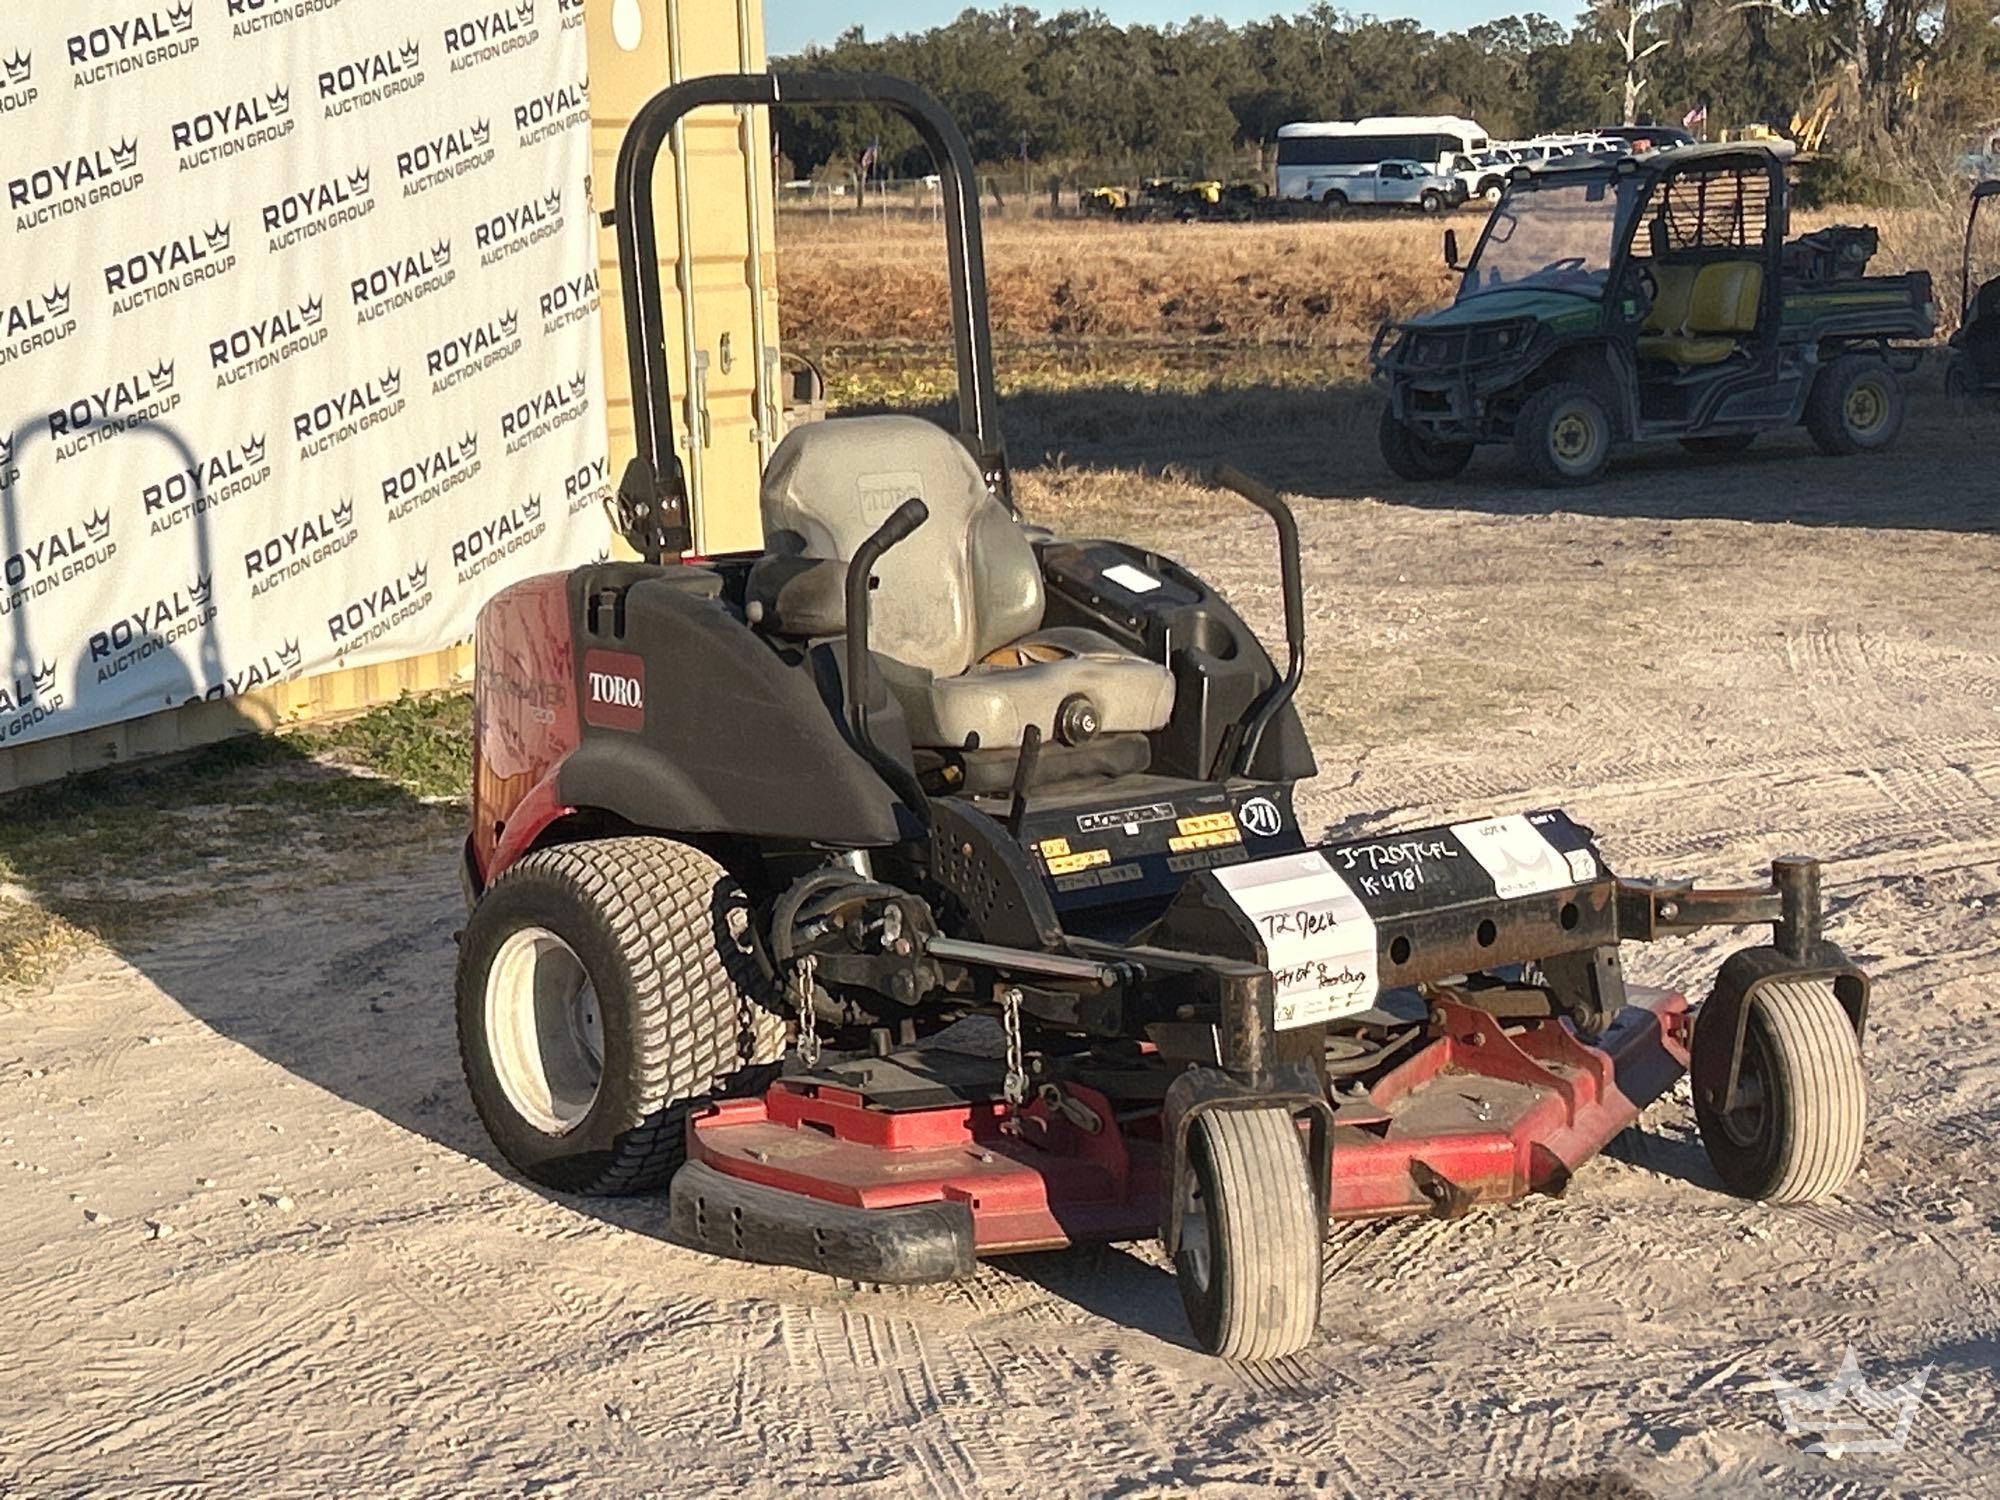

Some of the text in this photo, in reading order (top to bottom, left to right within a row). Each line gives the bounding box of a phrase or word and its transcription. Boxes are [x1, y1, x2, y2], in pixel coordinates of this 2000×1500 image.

[67, 13, 169, 66] ROYAL
[233, 7, 293, 40] AUCTION
[445, 10, 518, 53] ROYAL
[451, 30, 539, 72] AUCTION GROUP
[74, 37, 199, 89] AUCTION GROUP
[319, 51, 400, 99] ROYAL
[325, 72, 424, 119] AUCTION GROUP
[514, 85, 581, 130] ROYAL
[172, 98, 268, 151] ROYAL
[179, 119, 294, 172] AUCTION GROUP
[520, 120, 565, 148] AUCTION
[8, 151, 112, 209] ROYAL
[397, 129, 473, 178] ROYAL
[403, 149, 494, 198] AUCTION GROUP
[17, 173, 143, 233] AUCTION GROUP
[263, 179, 349, 232] ROYAL
[270, 199, 374, 254] AUCTION GROUP
[475, 198, 546, 249] ROYAL
[104, 236, 206, 294] ROYAL
[481, 217, 564, 267] AUCTION GROUP
[113, 255, 235, 316] AUCTION GROUP
[351, 252, 433, 305] ROYAL
[358, 270, 455, 325] AUCTION GROUP
[21, 319, 76, 354] GROUP
[210, 310, 300, 368] ROYAL
[217, 328, 328, 389] AUCTION GROUP
[427, 323, 501, 376] ROYAL
[432, 338, 521, 395] AUCTION GROUP
[49, 376, 149, 440] ROYAL
[56, 394, 180, 462] AUCTION GROUP
[294, 383, 381, 441] ROYAL
[301, 399, 405, 461] AUCTION GROUP
[502, 385, 570, 438] ROYAL
[506, 399, 588, 456] AUCTION GROUP
[143, 450, 243, 515] ROYAL
[151, 466, 270, 536] AUCTION GROUP
[382, 447, 460, 504] ROYAL
[388, 461, 481, 523] AUCTION GROUP
[62, 543, 117, 581] GROUP
[245, 515, 333, 578] ROYAL
[252, 529, 358, 598] AUCTION GROUP
[452, 508, 525, 567] ROYAL
[459, 522, 545, 584] AUCTION GROUP
[90, 592, 189, 662] ROYAL
[328, 579, 410, 641] ROYAL
[392, 592, 432, 626] GROUP
[98, 605, 217, 684] AUCTION GROUP
[10, 694, 63, 736] GROUP
[588, 672, 643, 708] TORO
